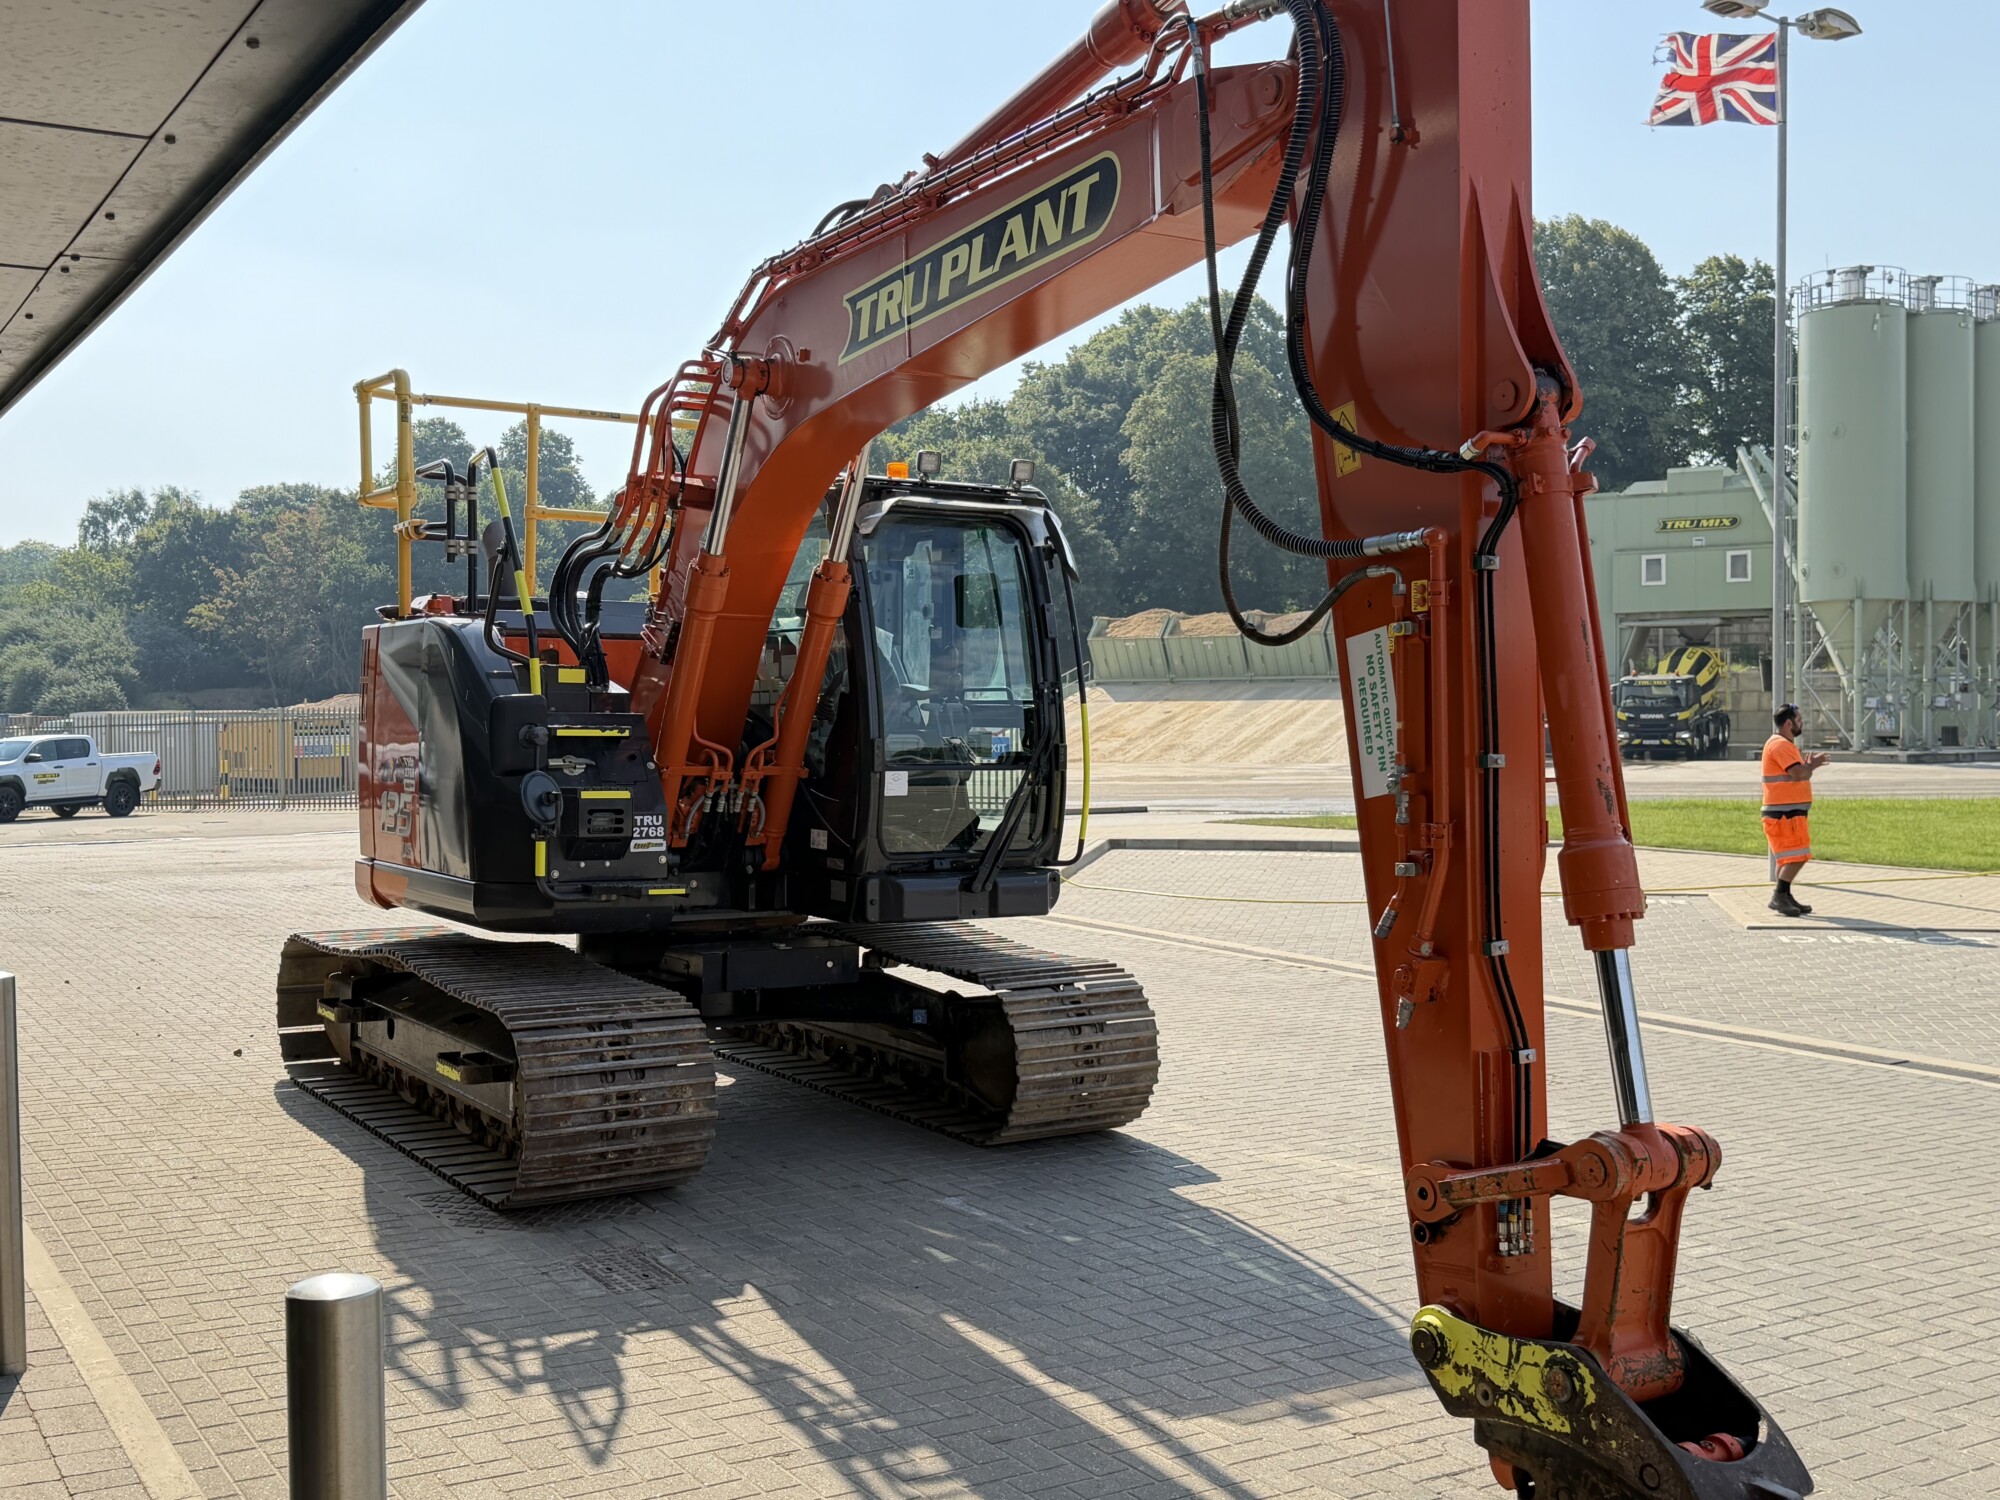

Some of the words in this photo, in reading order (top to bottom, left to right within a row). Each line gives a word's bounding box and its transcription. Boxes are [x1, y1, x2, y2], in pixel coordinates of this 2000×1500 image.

[1665, 520, 1698, 529] TRU
[1699, 517, 1732, 527] MIX
[1366, 654, 1376, 677] NO
[1374, 633, 1389, 704] AUTOMATIC
[1383, 707, 1394, 748] QUICK
[1357, 677, 1374, 756] REQUIRED
[1369, 681, 1383, 740] SAFETY
[991, 744, 1007, 752] XIT
[1377, 745, 1387, 772] PIN
[633, 827, 664, 837] 2768
[634, 815, 662, 826] TRU
